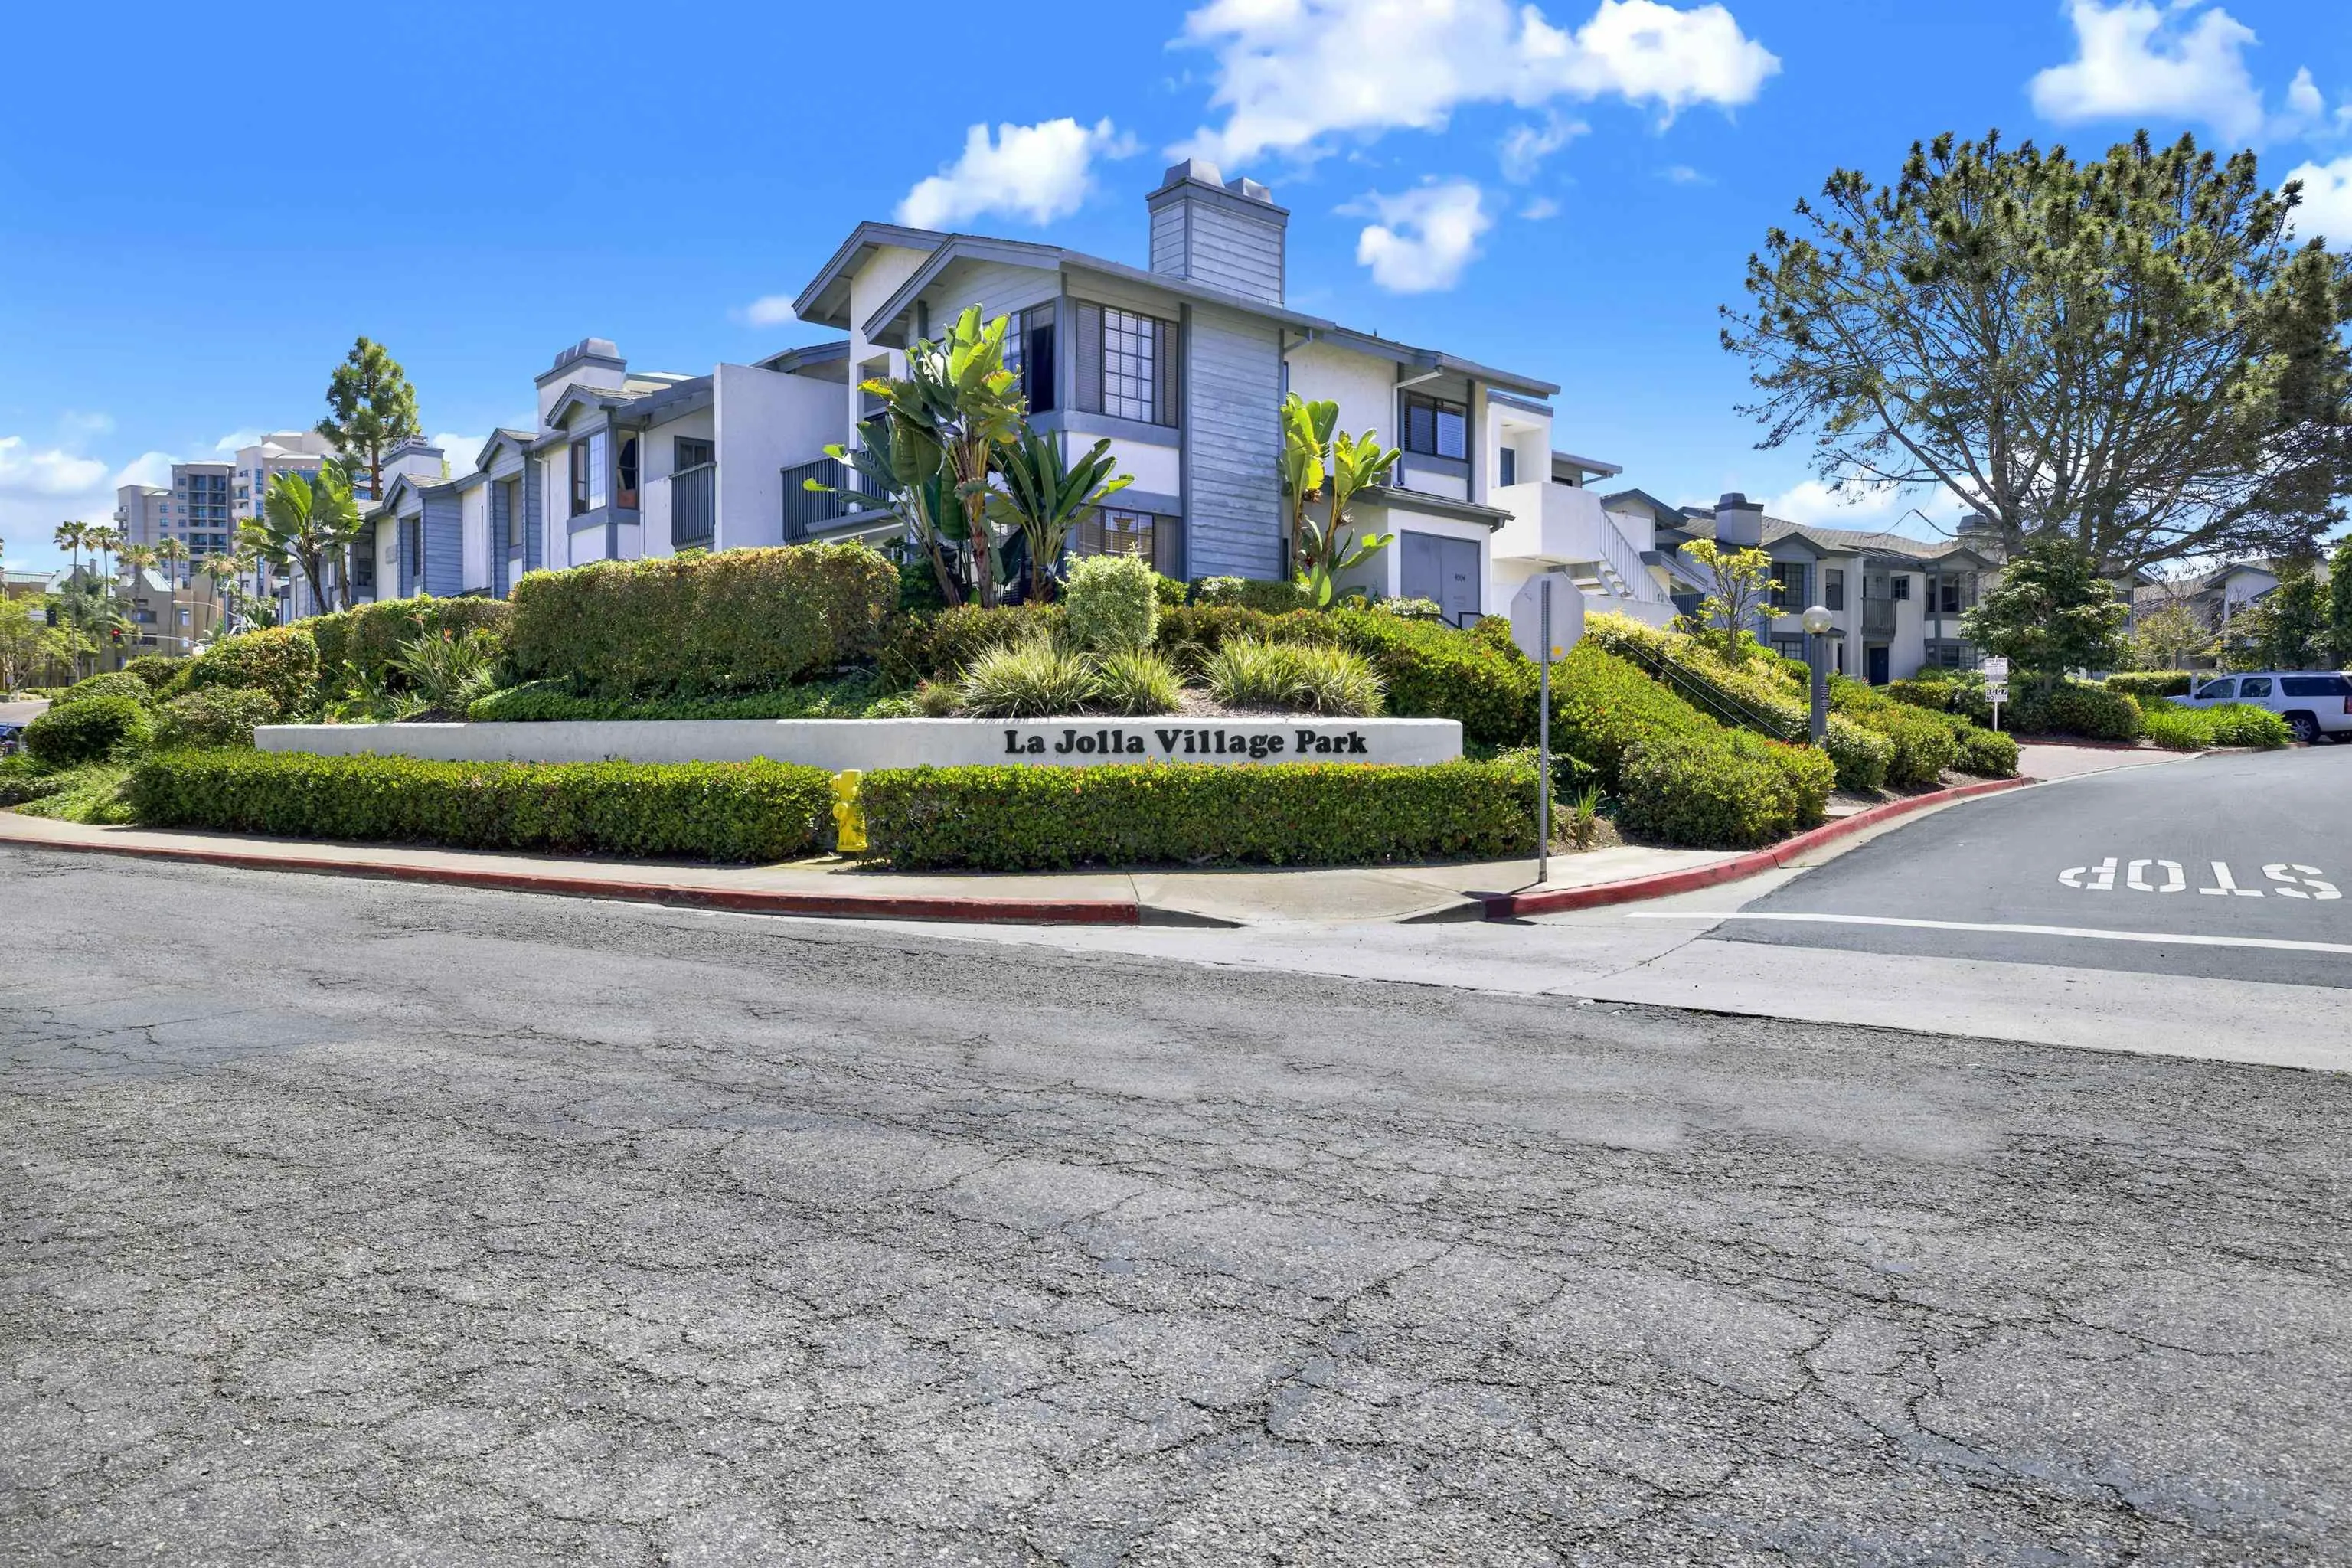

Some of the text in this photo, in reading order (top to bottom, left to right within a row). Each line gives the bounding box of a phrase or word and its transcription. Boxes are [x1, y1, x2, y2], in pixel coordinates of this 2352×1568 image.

[1004, 729, 1367, 759] La Jolla Village Park
[2057, 858, 2343, 900] STOP
